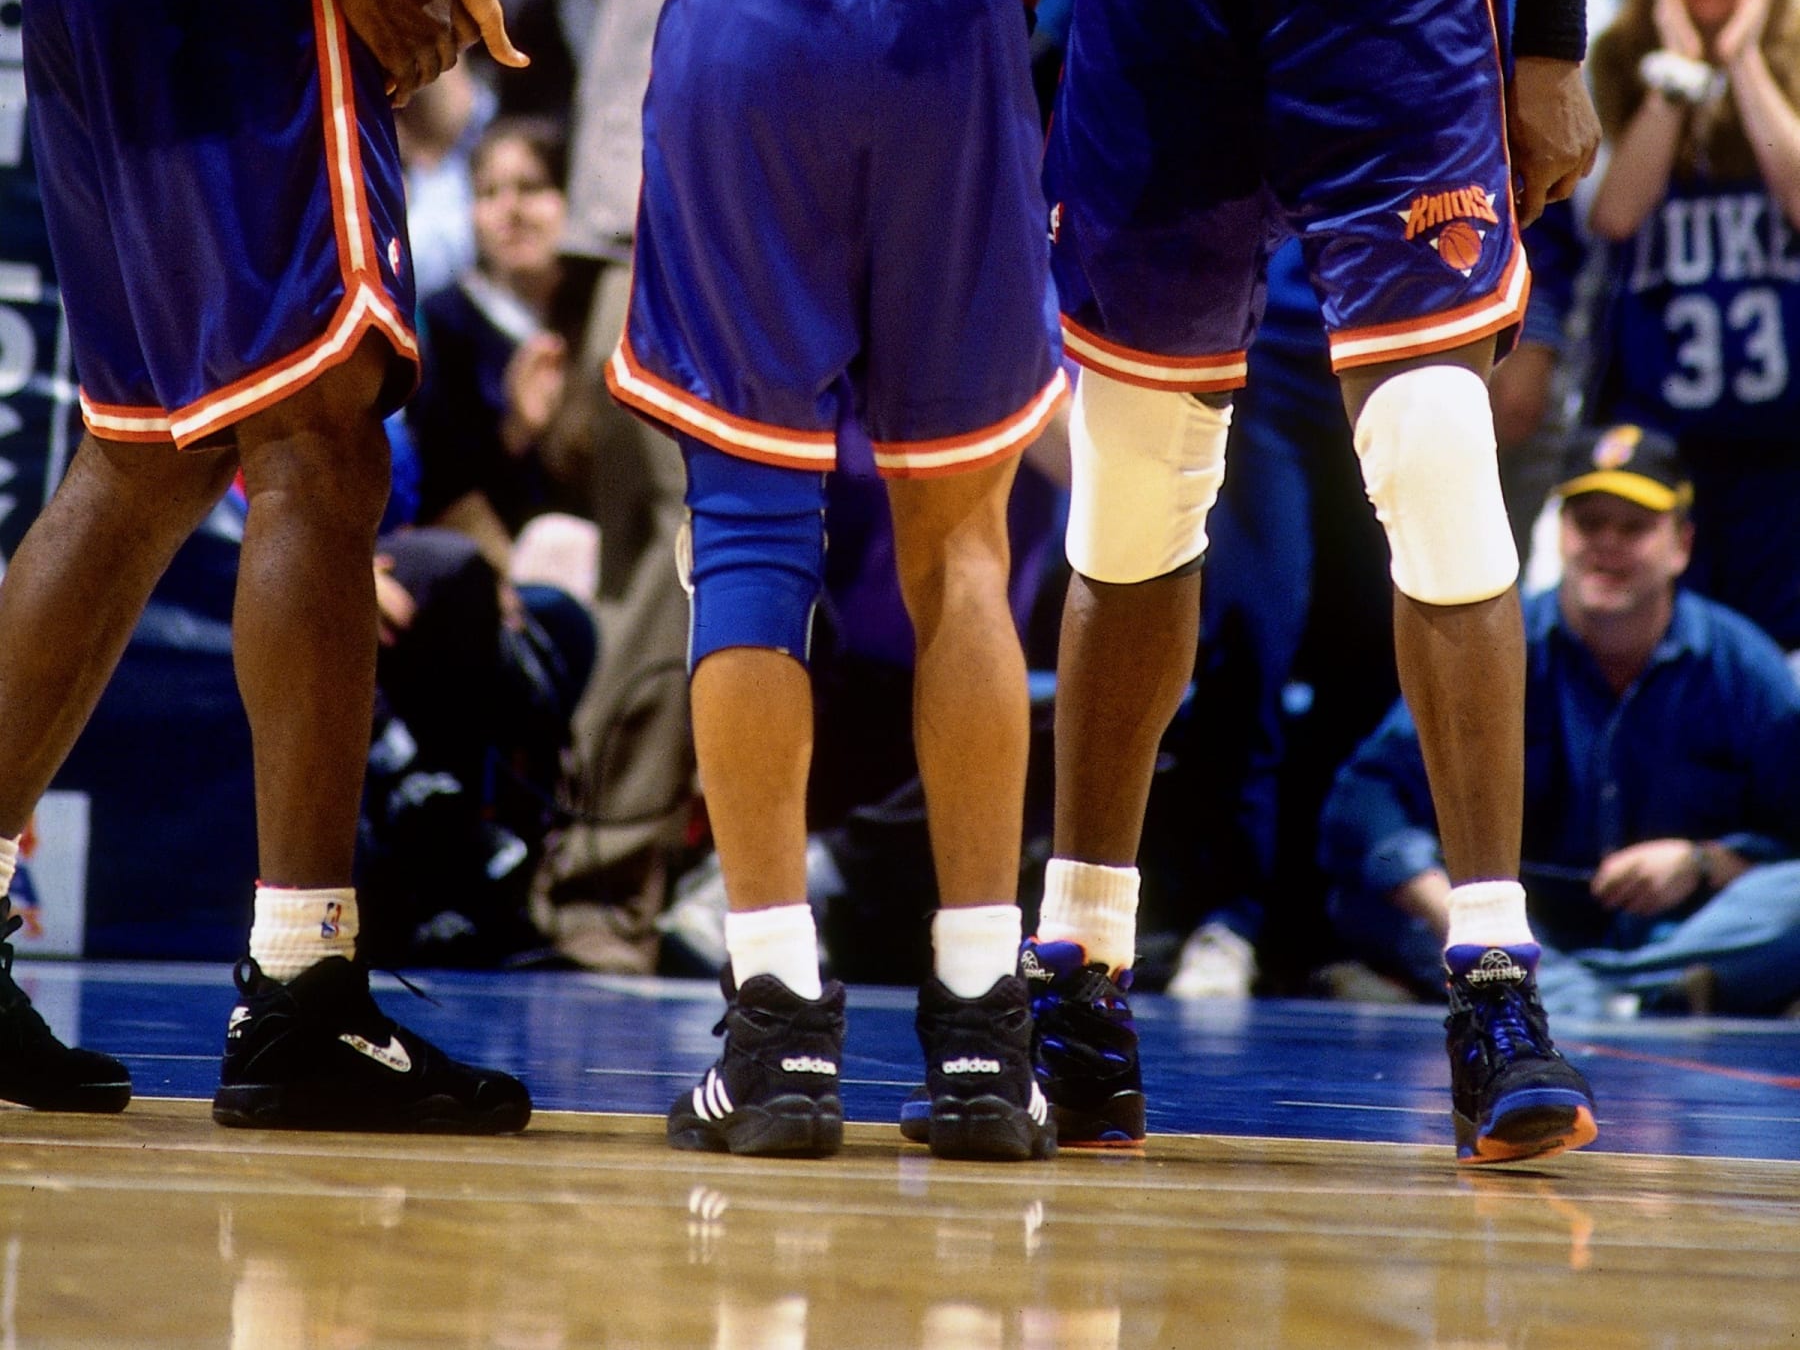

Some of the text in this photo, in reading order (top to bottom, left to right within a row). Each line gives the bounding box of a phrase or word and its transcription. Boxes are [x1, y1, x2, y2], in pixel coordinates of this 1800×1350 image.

[1405, 184, 1499, 240] KNICKS
[1661, 287, 1790, 408] 33
[1471, 966, 1521, 982] EWING
[781, 1056, 837, 1076] adidas
[942, 1057, 1000, 1074] adidas
